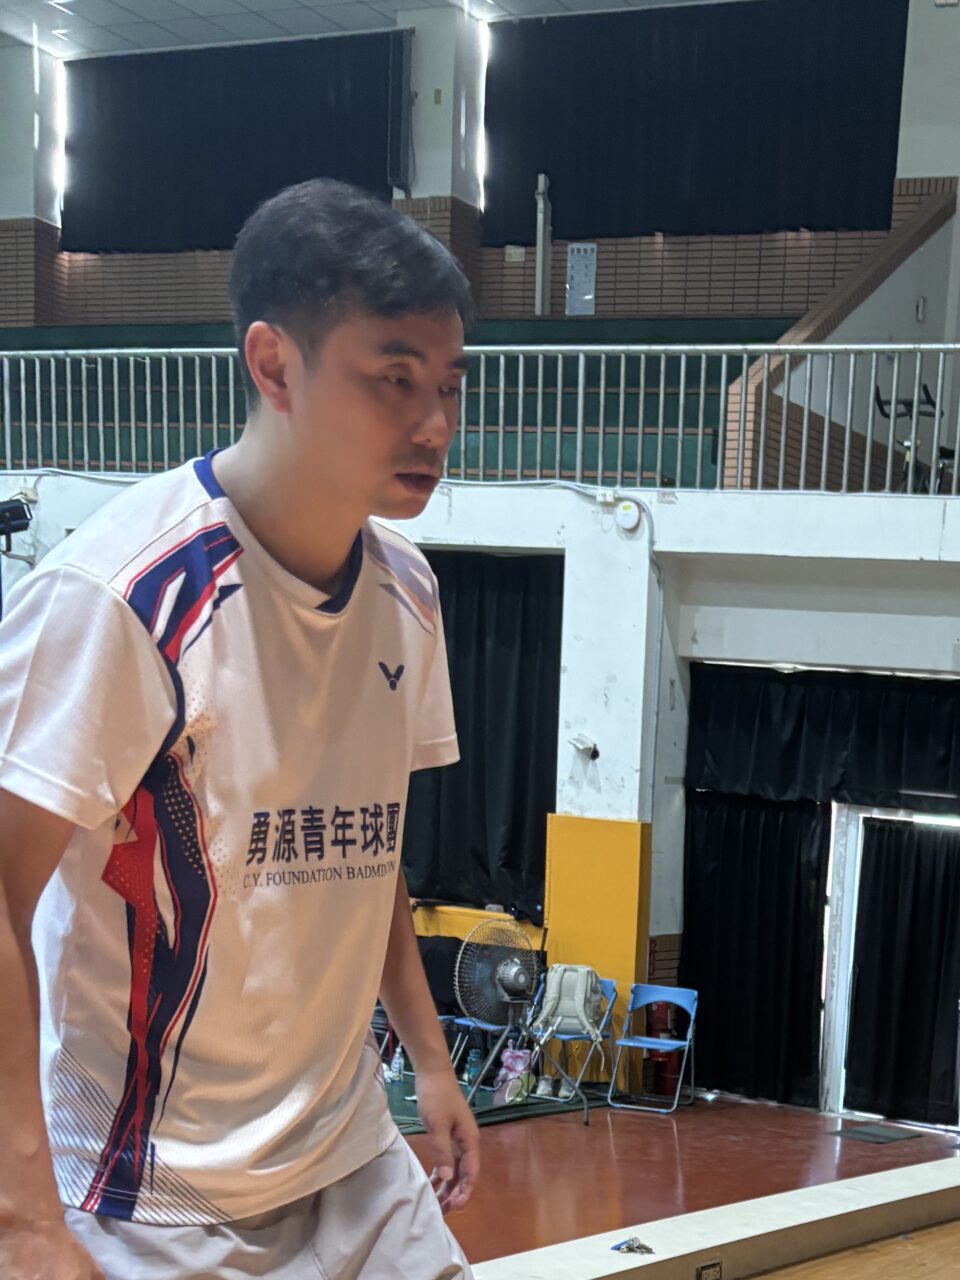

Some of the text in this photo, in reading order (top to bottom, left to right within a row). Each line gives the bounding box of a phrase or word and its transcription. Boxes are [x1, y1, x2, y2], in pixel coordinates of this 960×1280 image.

[245, 802, 401, 866] 勇源青年球團
[266, 867, 342, 886] FOUNDATION
